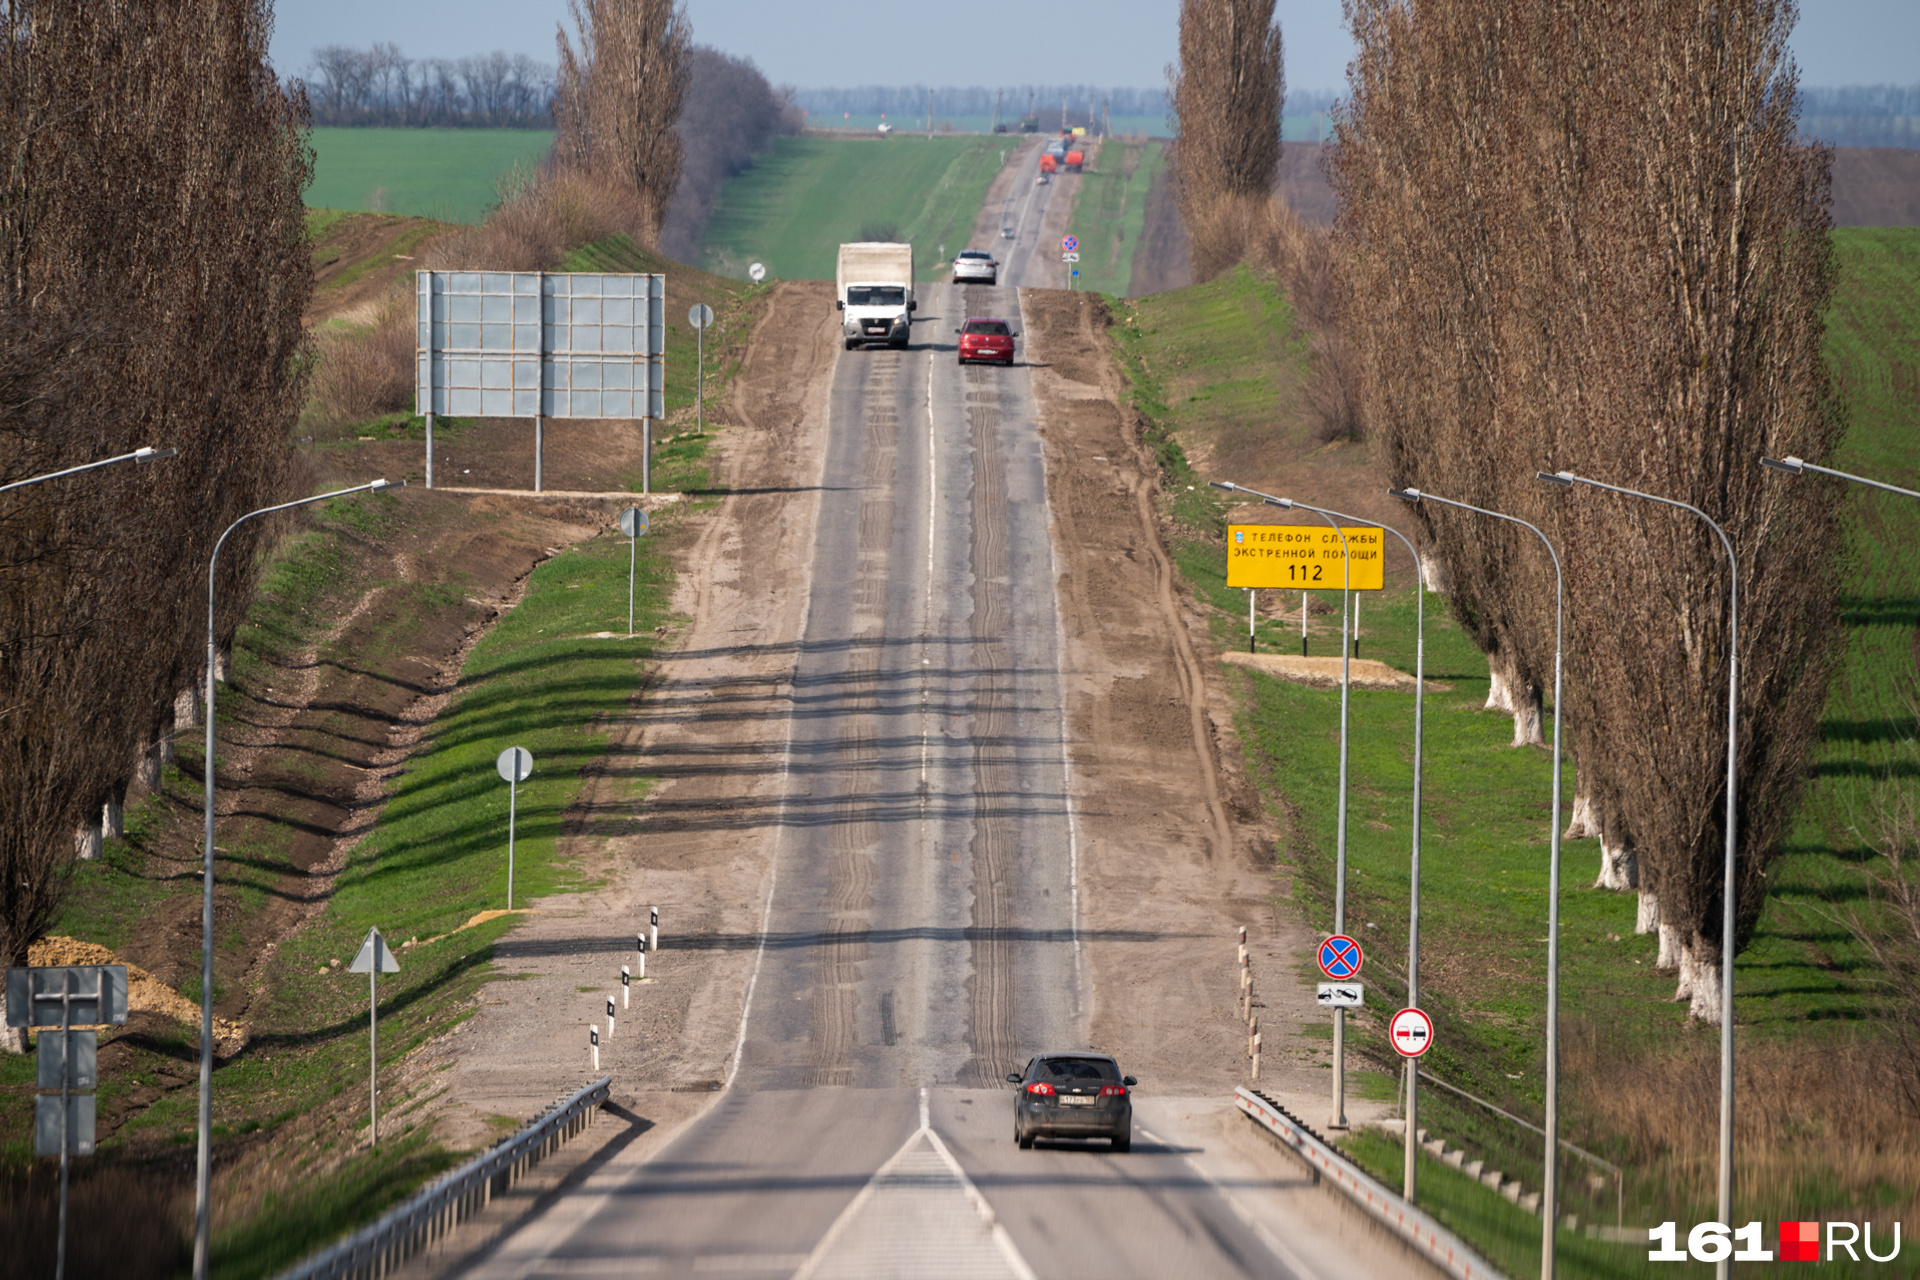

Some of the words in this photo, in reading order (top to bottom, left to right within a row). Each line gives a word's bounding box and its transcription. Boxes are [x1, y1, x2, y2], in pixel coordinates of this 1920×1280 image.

[1251, 532, 1311, 543] ТЕЛЕФОН
[1234, 548, 1315, 558] ЭКСТРЕННОЙ
[1288, 564, 1323, 581] 112
